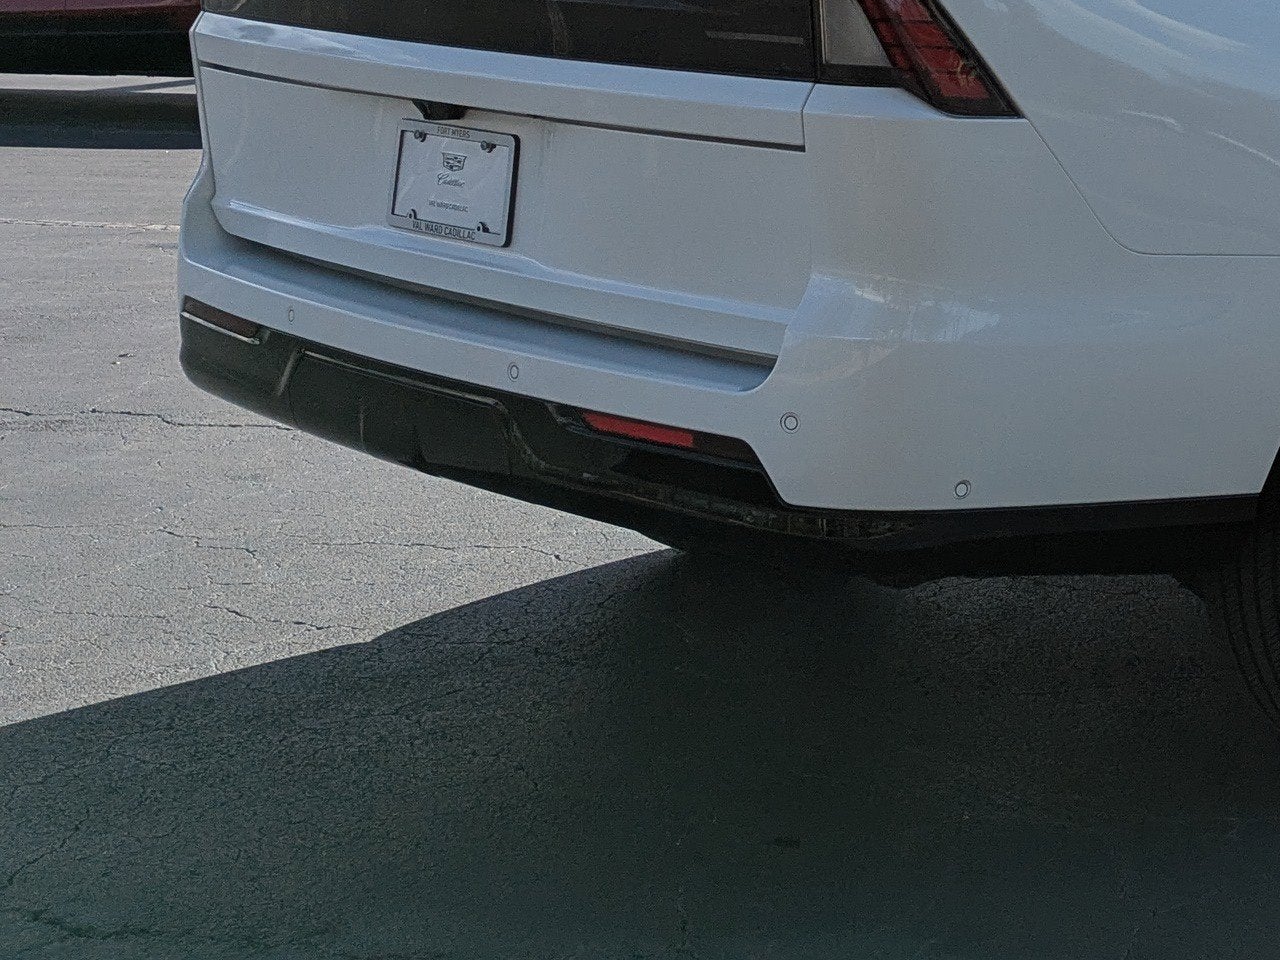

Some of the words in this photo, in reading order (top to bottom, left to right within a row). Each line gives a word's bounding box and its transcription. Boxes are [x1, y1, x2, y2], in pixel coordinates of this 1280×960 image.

[412, 220, 423, 230] VAL
[424, 222, 443, 235] WARD
[443, 225, 476, 240] CADILLAC
